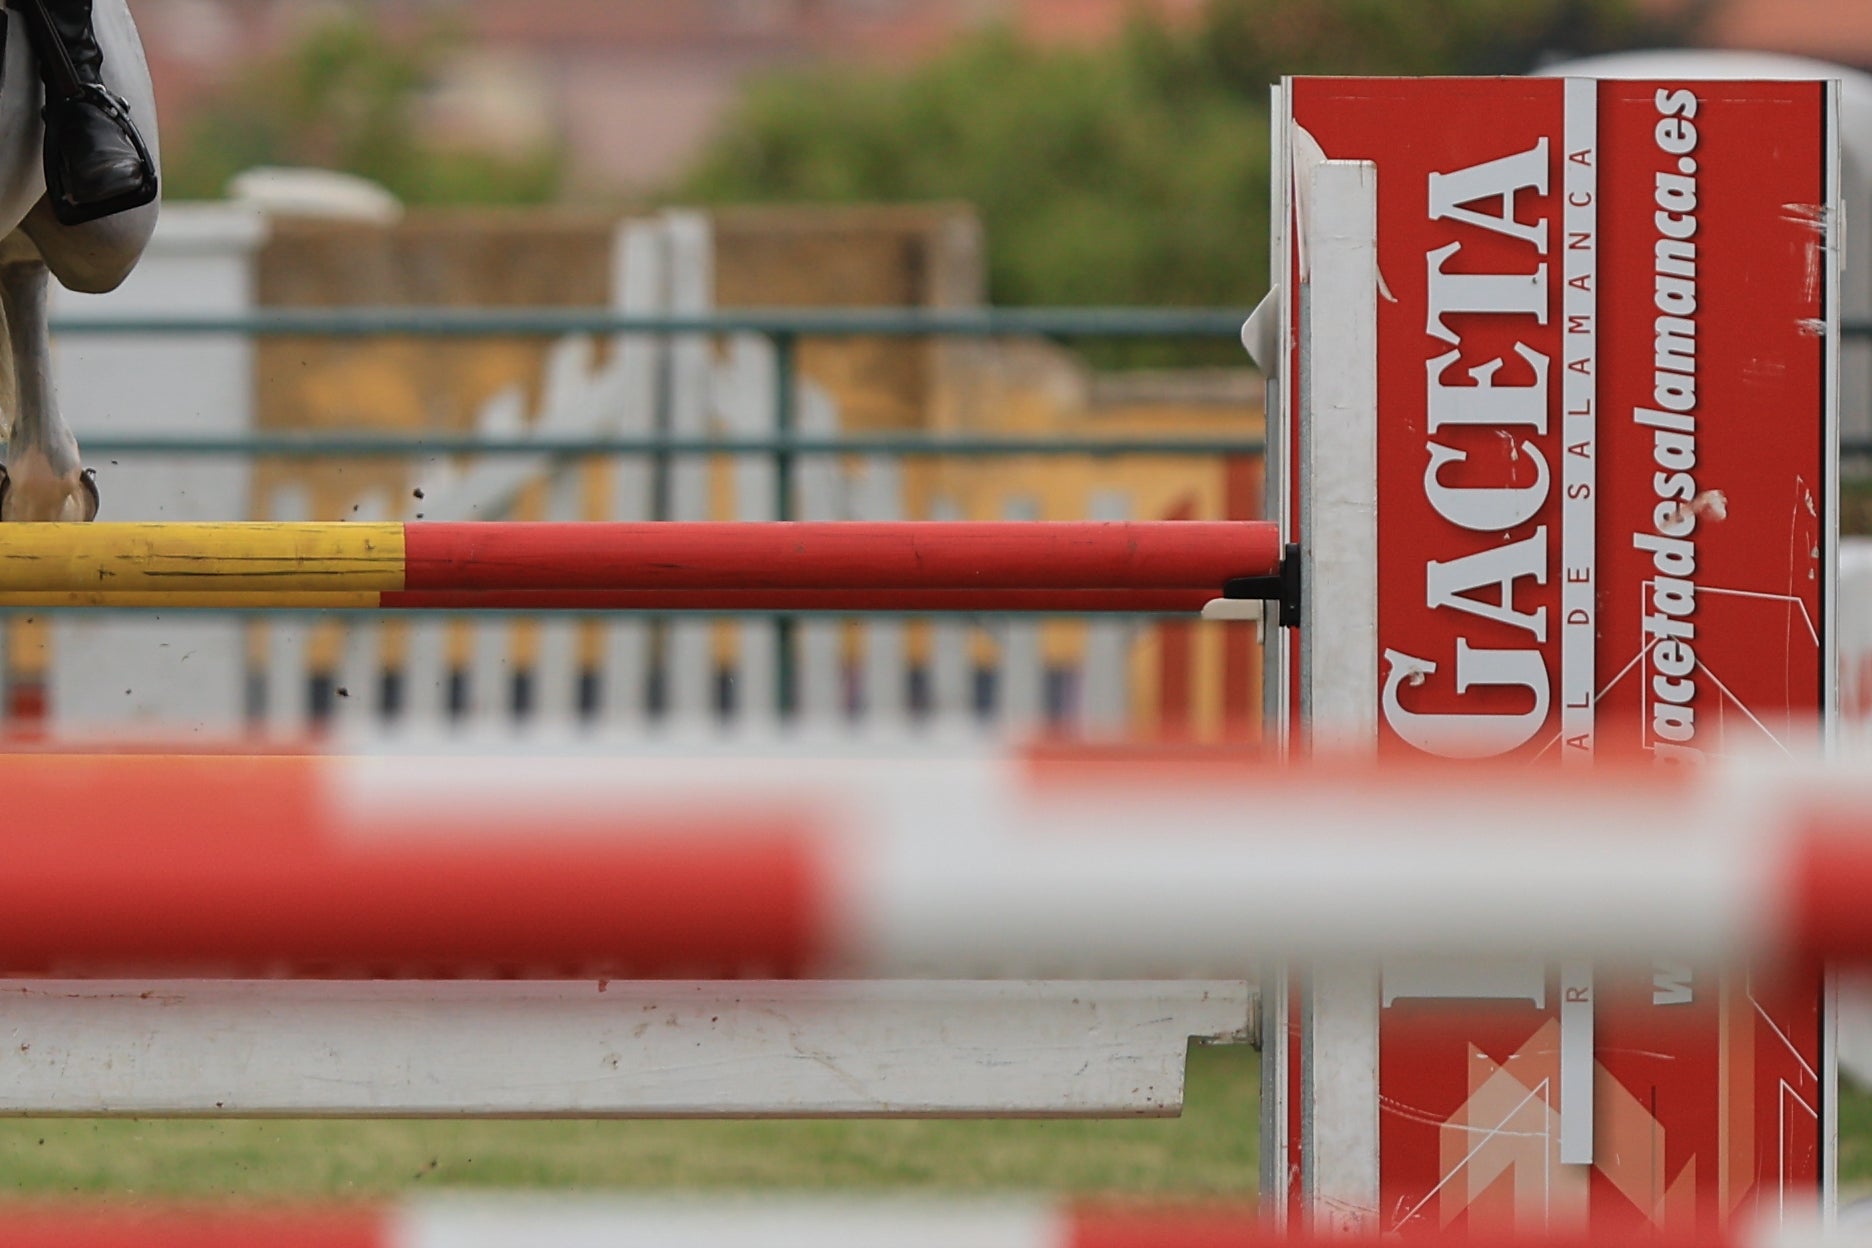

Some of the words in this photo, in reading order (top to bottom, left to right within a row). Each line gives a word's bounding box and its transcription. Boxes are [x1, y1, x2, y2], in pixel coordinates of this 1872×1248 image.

[1381, 136, 1551, 759] GACETA
[1566, 147, 1592, 500] SALAMANCA
[1566, 565, 1591, 626] DE
